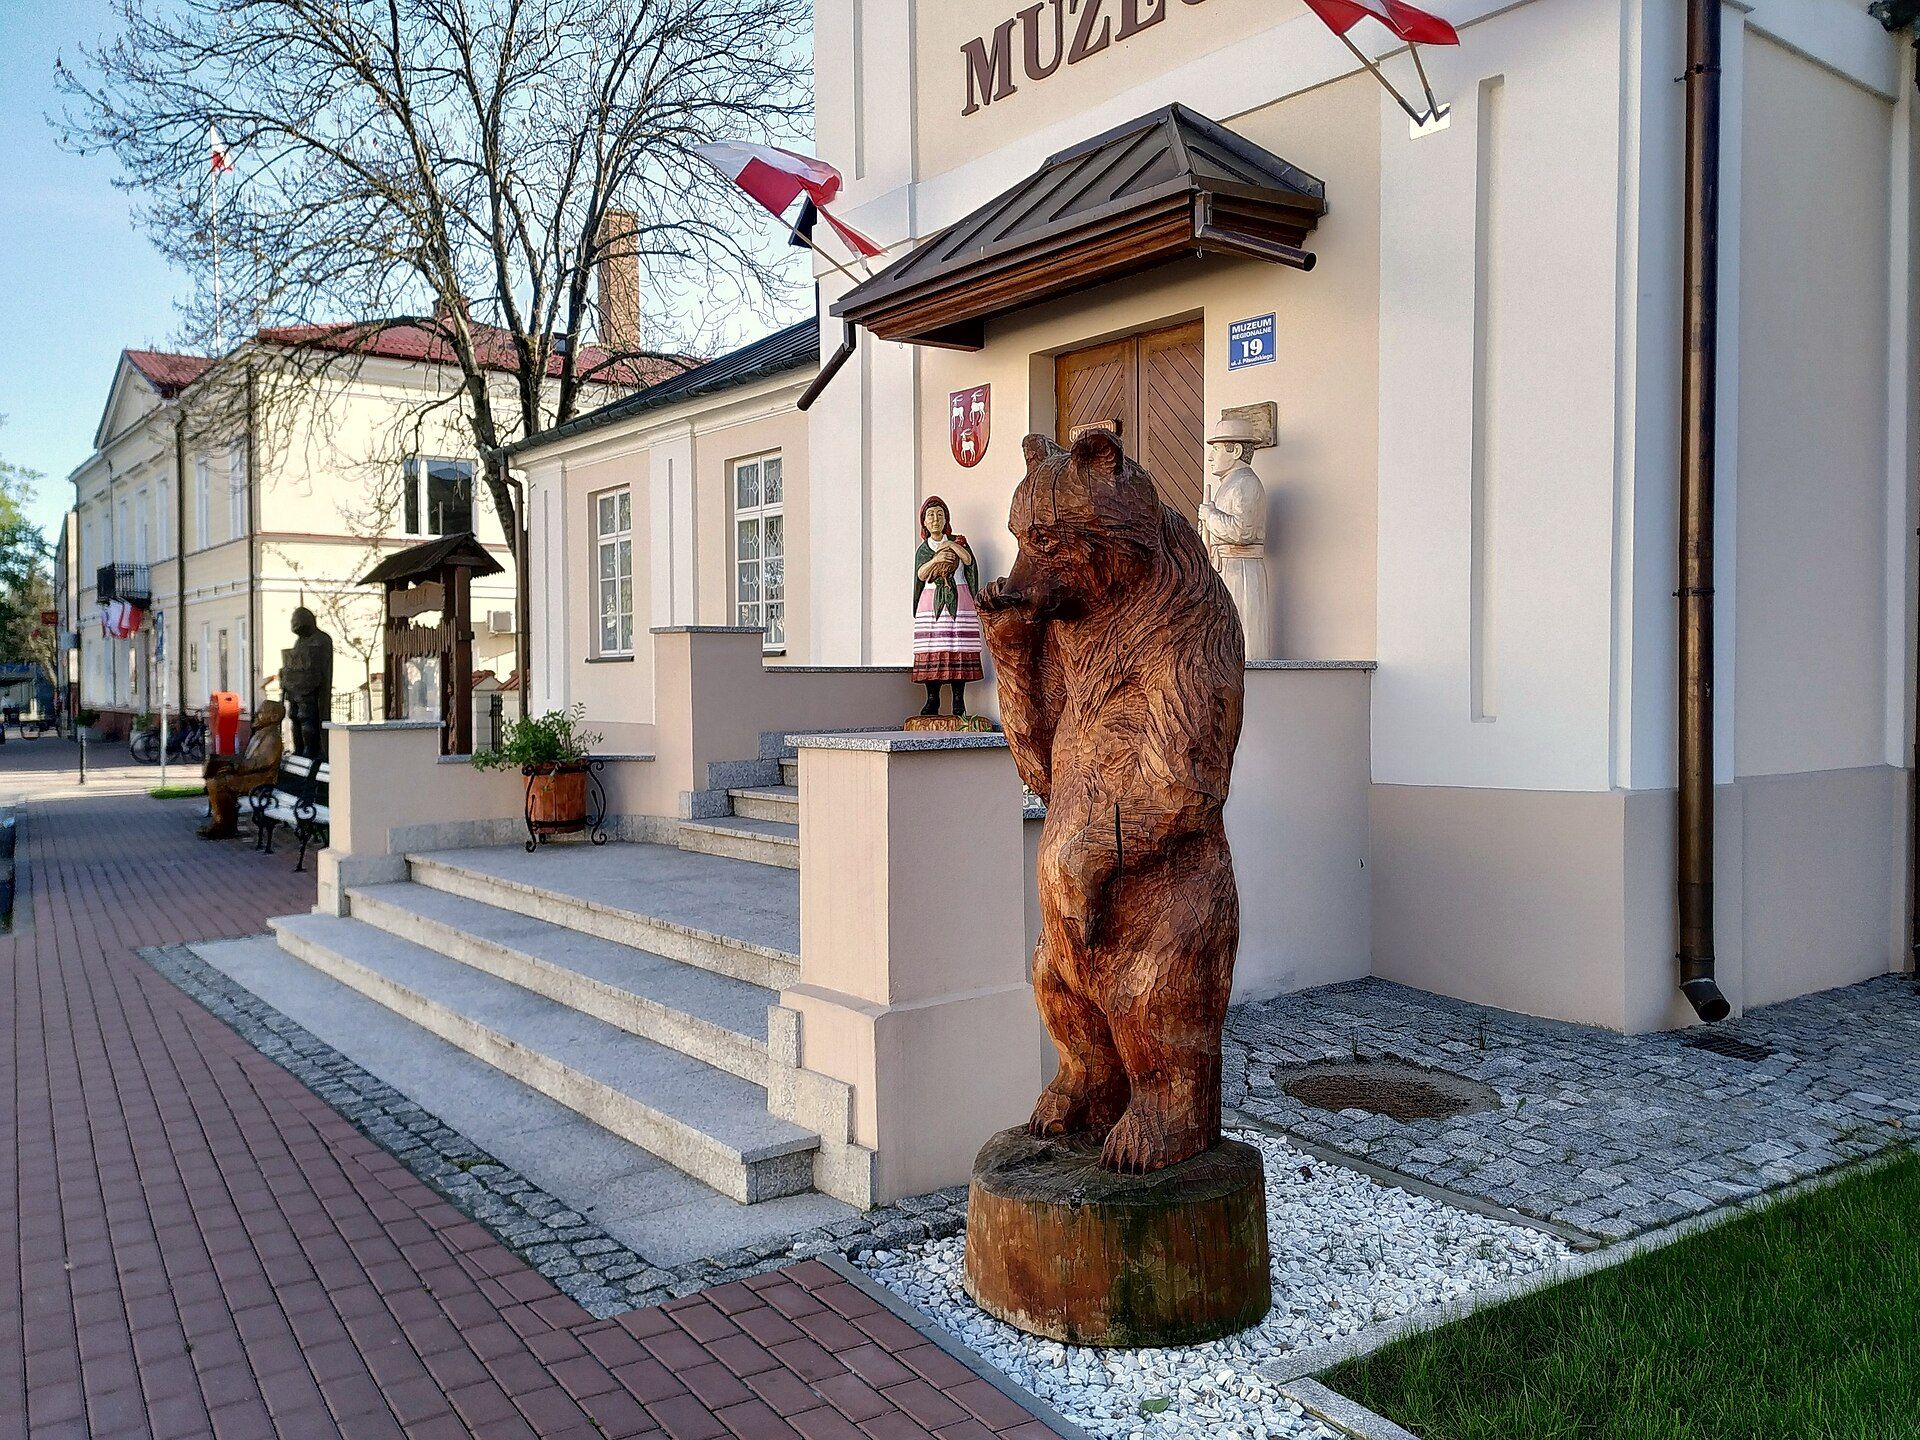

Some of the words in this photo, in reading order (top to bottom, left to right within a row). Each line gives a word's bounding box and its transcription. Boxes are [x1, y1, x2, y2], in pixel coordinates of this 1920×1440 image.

[1232, 318, 1272, 334] MUZEUM
[1232, 327, 1272, 340] REGIONALNE
[1242, 338, 1263, 358] 19
